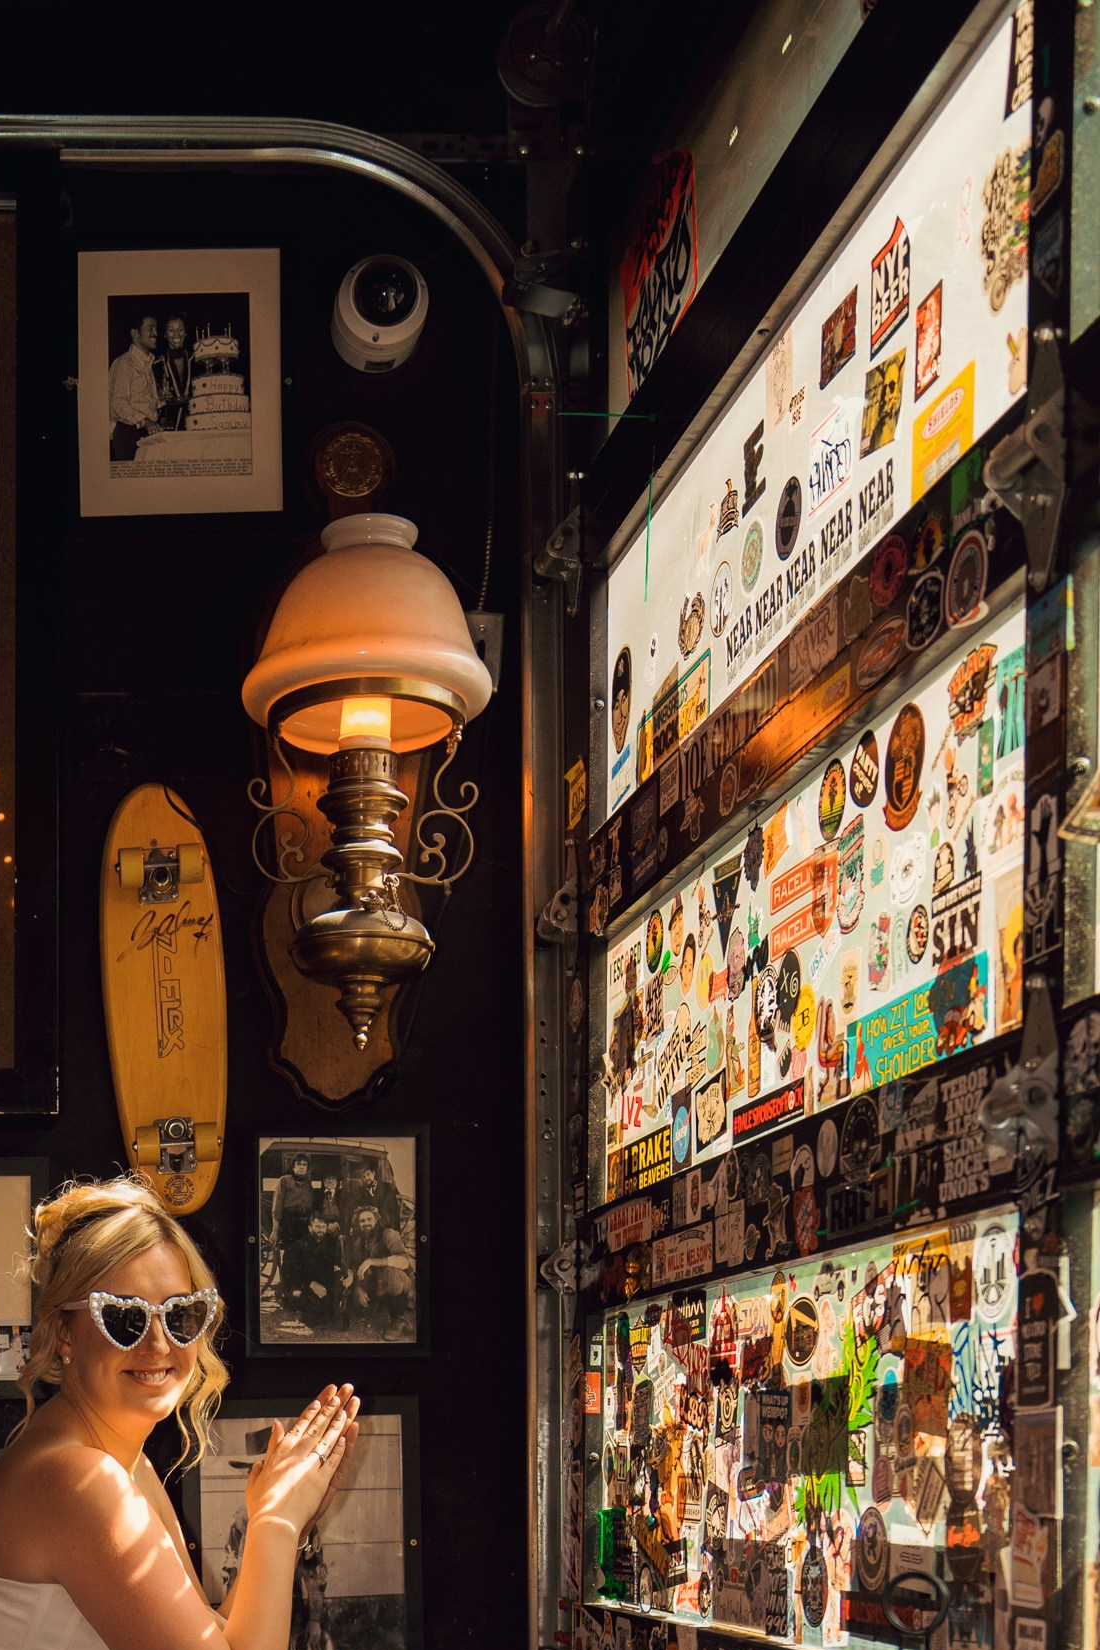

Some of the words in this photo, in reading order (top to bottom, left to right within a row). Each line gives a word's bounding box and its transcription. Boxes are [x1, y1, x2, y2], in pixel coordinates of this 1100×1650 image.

[872, 233, 910, 301] NYF
[871, 268, 910, 334] BEER
[205, 397, 250, 412] Birthday
[209, 381, 240, 395] Happy
[926, 392, 960, 431] SHIELDS
[725, 604, 752, 668] NEAR
[755, 574, 783, 636] NEAR
[786, 539, 815, 605] NEAR
[820, 499, 852, 565] NEAR
[858, 457, 893, 528] NEAR
[932, 901, 979, 967] SIN
[866, 1013, 888, 1047] HOW
[882, 1030, 906, 1052] OVER
[908, 1018, 932, 1042] YOUR
[875, 1036, 937, 1087] SHOULDER
[631, 1128, 671, 1172] BRAKE
[624, 1175, 638, 1198] FOR
[638, 1160, 671, 1189] BEAVERS
[667, 1251, 684, 1273] WILLIE
[760, 1406, 789, 1420] WEIRDO?
